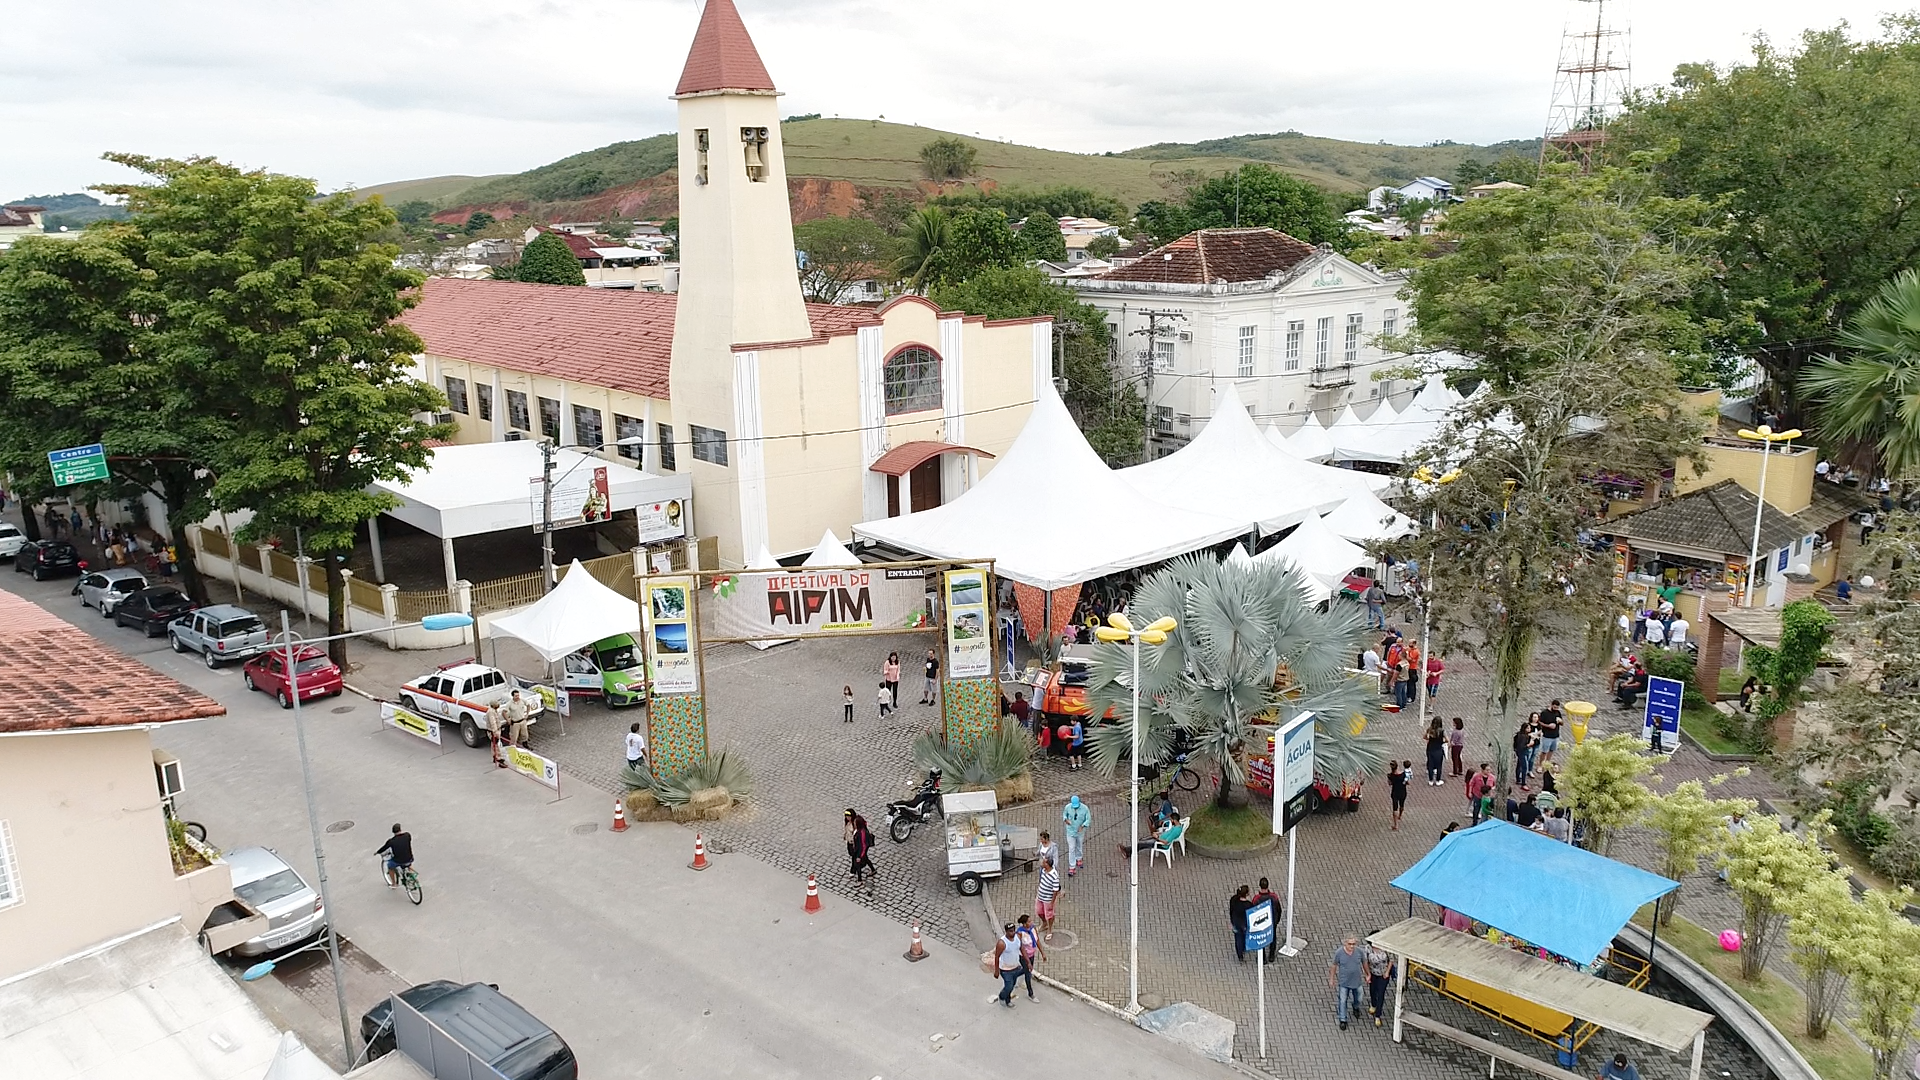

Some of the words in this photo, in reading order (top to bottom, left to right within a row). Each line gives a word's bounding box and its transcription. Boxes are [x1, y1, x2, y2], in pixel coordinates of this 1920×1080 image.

[60, 449, 91, 458] Centro
[780, 575, 846, 590] FESTIVAL
[850, 573, 870, 587] DO
[887, 569, 924, 577] ENTRADA
[767, 587, 873, 625] AIPIM
[1286, 739, 1312, 767] ÁGUA
